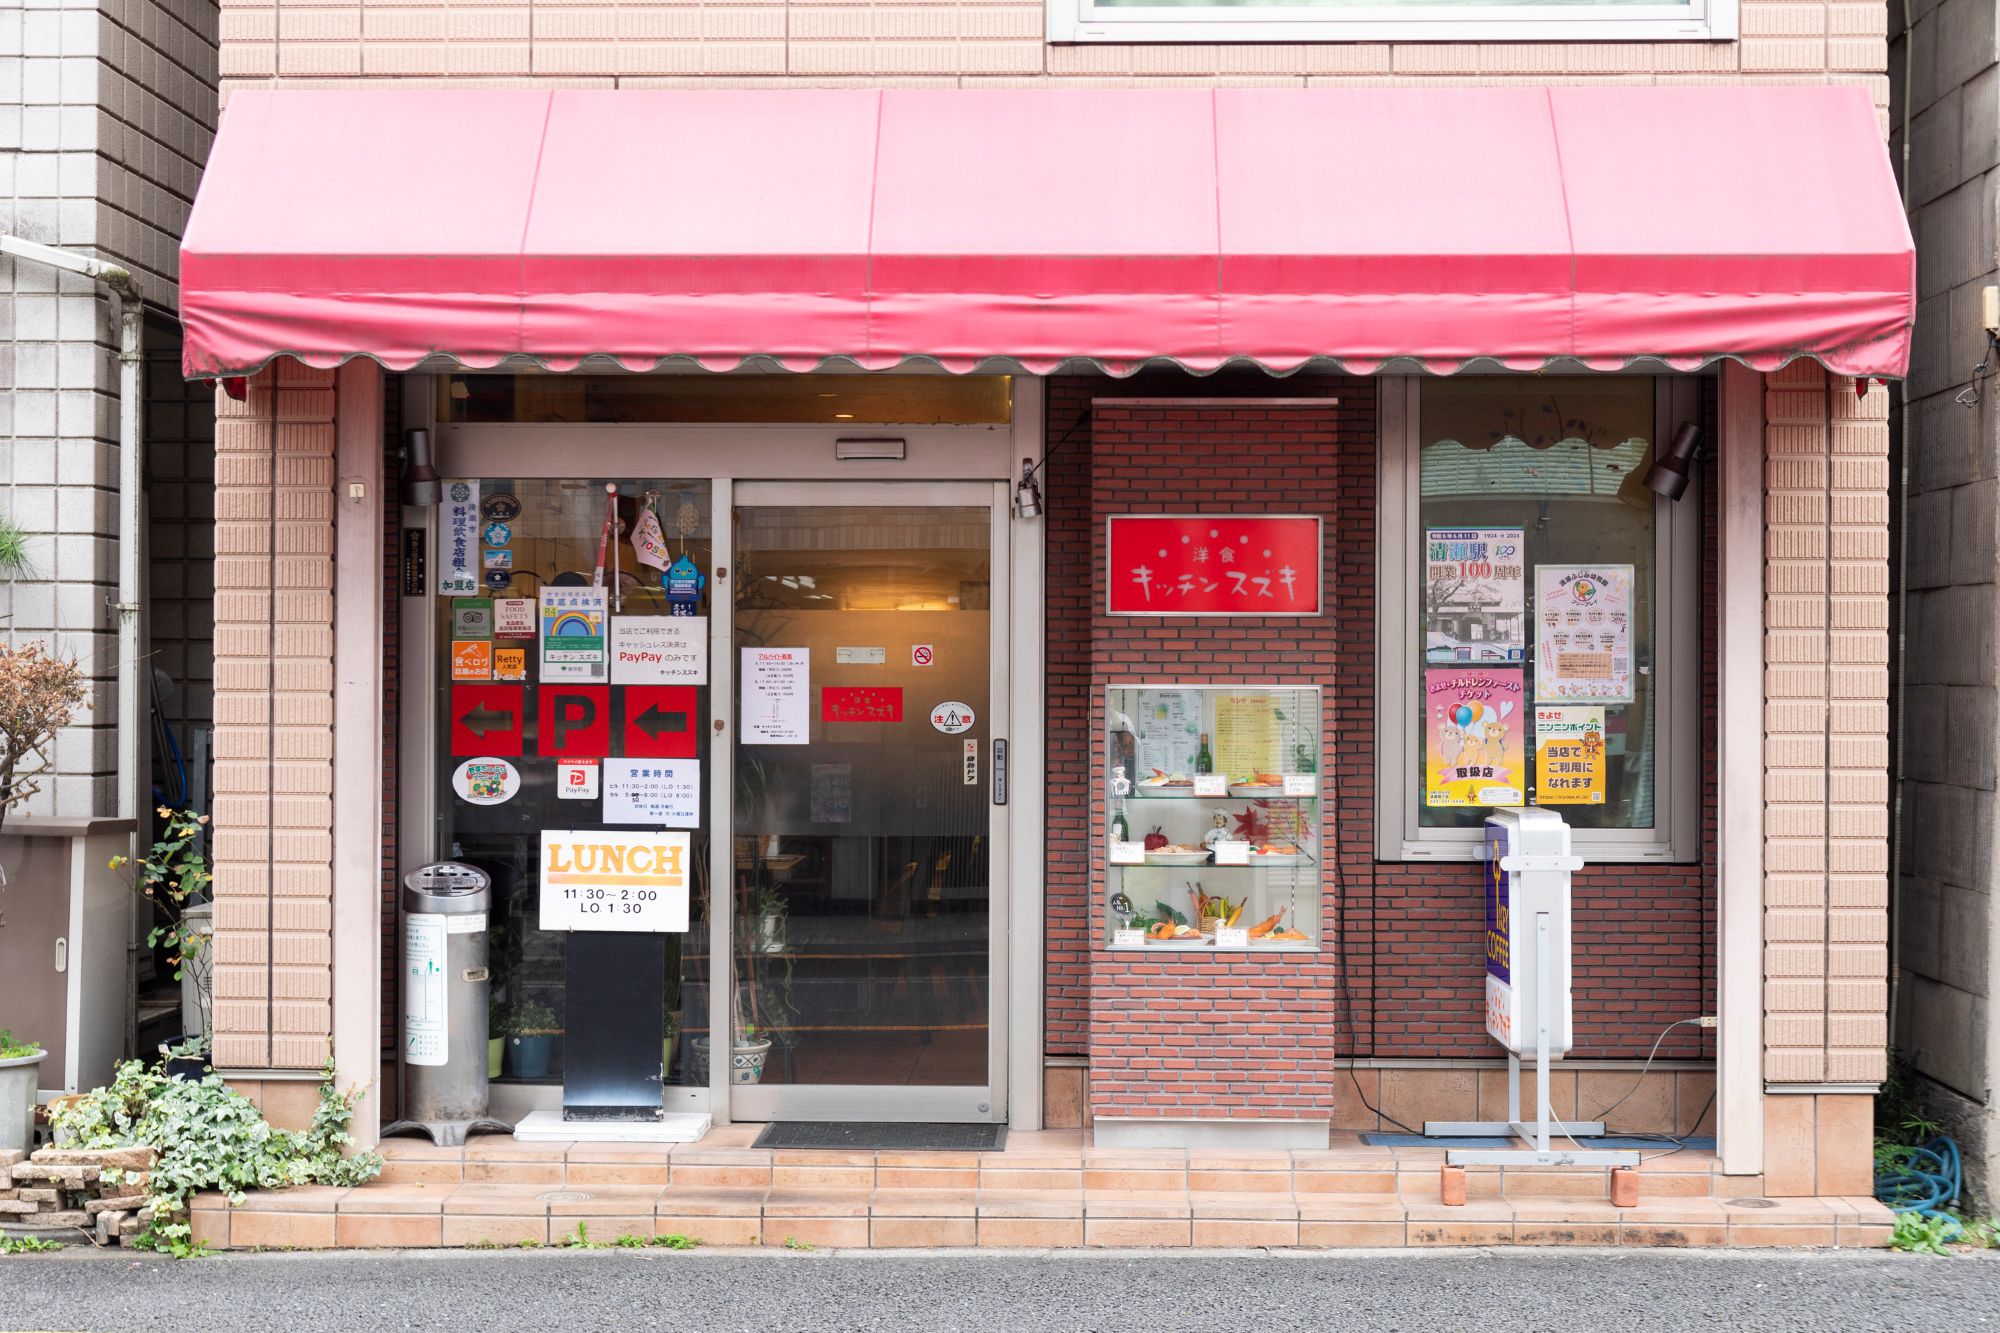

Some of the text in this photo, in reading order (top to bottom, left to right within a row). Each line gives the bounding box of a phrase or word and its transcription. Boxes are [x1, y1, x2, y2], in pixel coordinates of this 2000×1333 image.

[1193, 546, 1236, 564] 洋食
[1430, 542, 1489, 561] 清瀬駅
[1429, 561, 1522, 580] 開業100周年
[442, 580, 476, 591] 加盟店
[1131, 564, 1297, 603] キッチンスズキ
[619, 627, 681, 635] 当店でご利用できる
[618, 641, 688, 649] キャッシュレス決済は
[455, 656, 489, 667] 食べログ
[497, 655, 523, 665] Retty
[619, 651, 698, 663] PayPay のみです
[1458, 689, 1493, 701] チケット
[831, 704, 895, 720] キッチンスズキ
[1537, 712, 1562, 720] きよせ
[554, 695, 596, 749] P
[1537, 723, 1602, 732] ニンニンポイント
[1547, 746, 1581, 758] 当店で
[966, 755, 976, 782] 自動ドア
[1456, 766, 1494, 778] 取扱店
[1548, 761, 1594, 773] ご利用に
[630, 769, 673, 778] 営業時間
[1548, 777, 1593, 789] なれます
[565, 786, 590, 794] PayPay
[547, 844, 683, 875] LUNCH
[607, 903, 642, 914] 1:30
[1498, 904, 1509, 936] KEY
[1487, 929, 1509, 969] COFFEE
